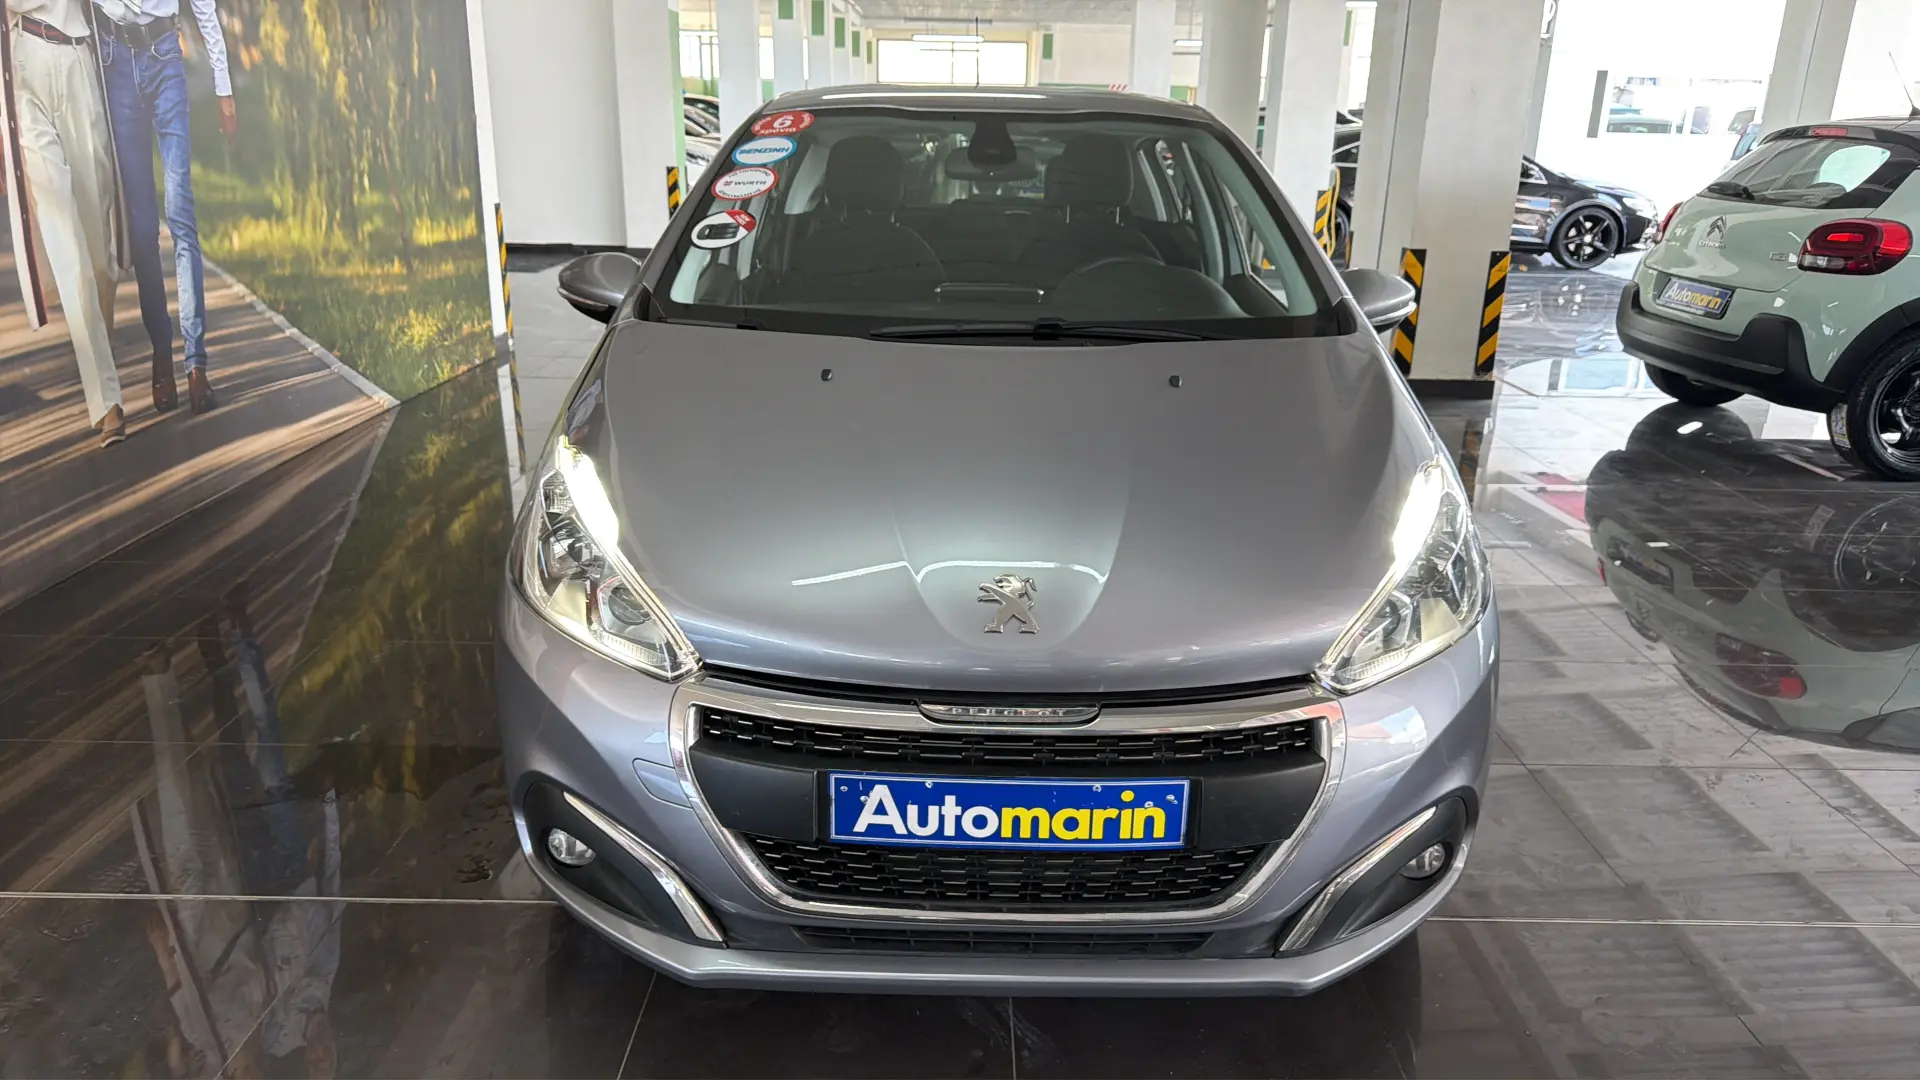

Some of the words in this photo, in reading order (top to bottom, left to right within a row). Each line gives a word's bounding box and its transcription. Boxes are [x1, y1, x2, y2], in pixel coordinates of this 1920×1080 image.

[773, 115, 794, 128] 6
[1664, 282, 1722, 310] Automarin
[952, 707, 1067, 716] PEUGEOT
[852, 784, 1166, 840] Automarin
